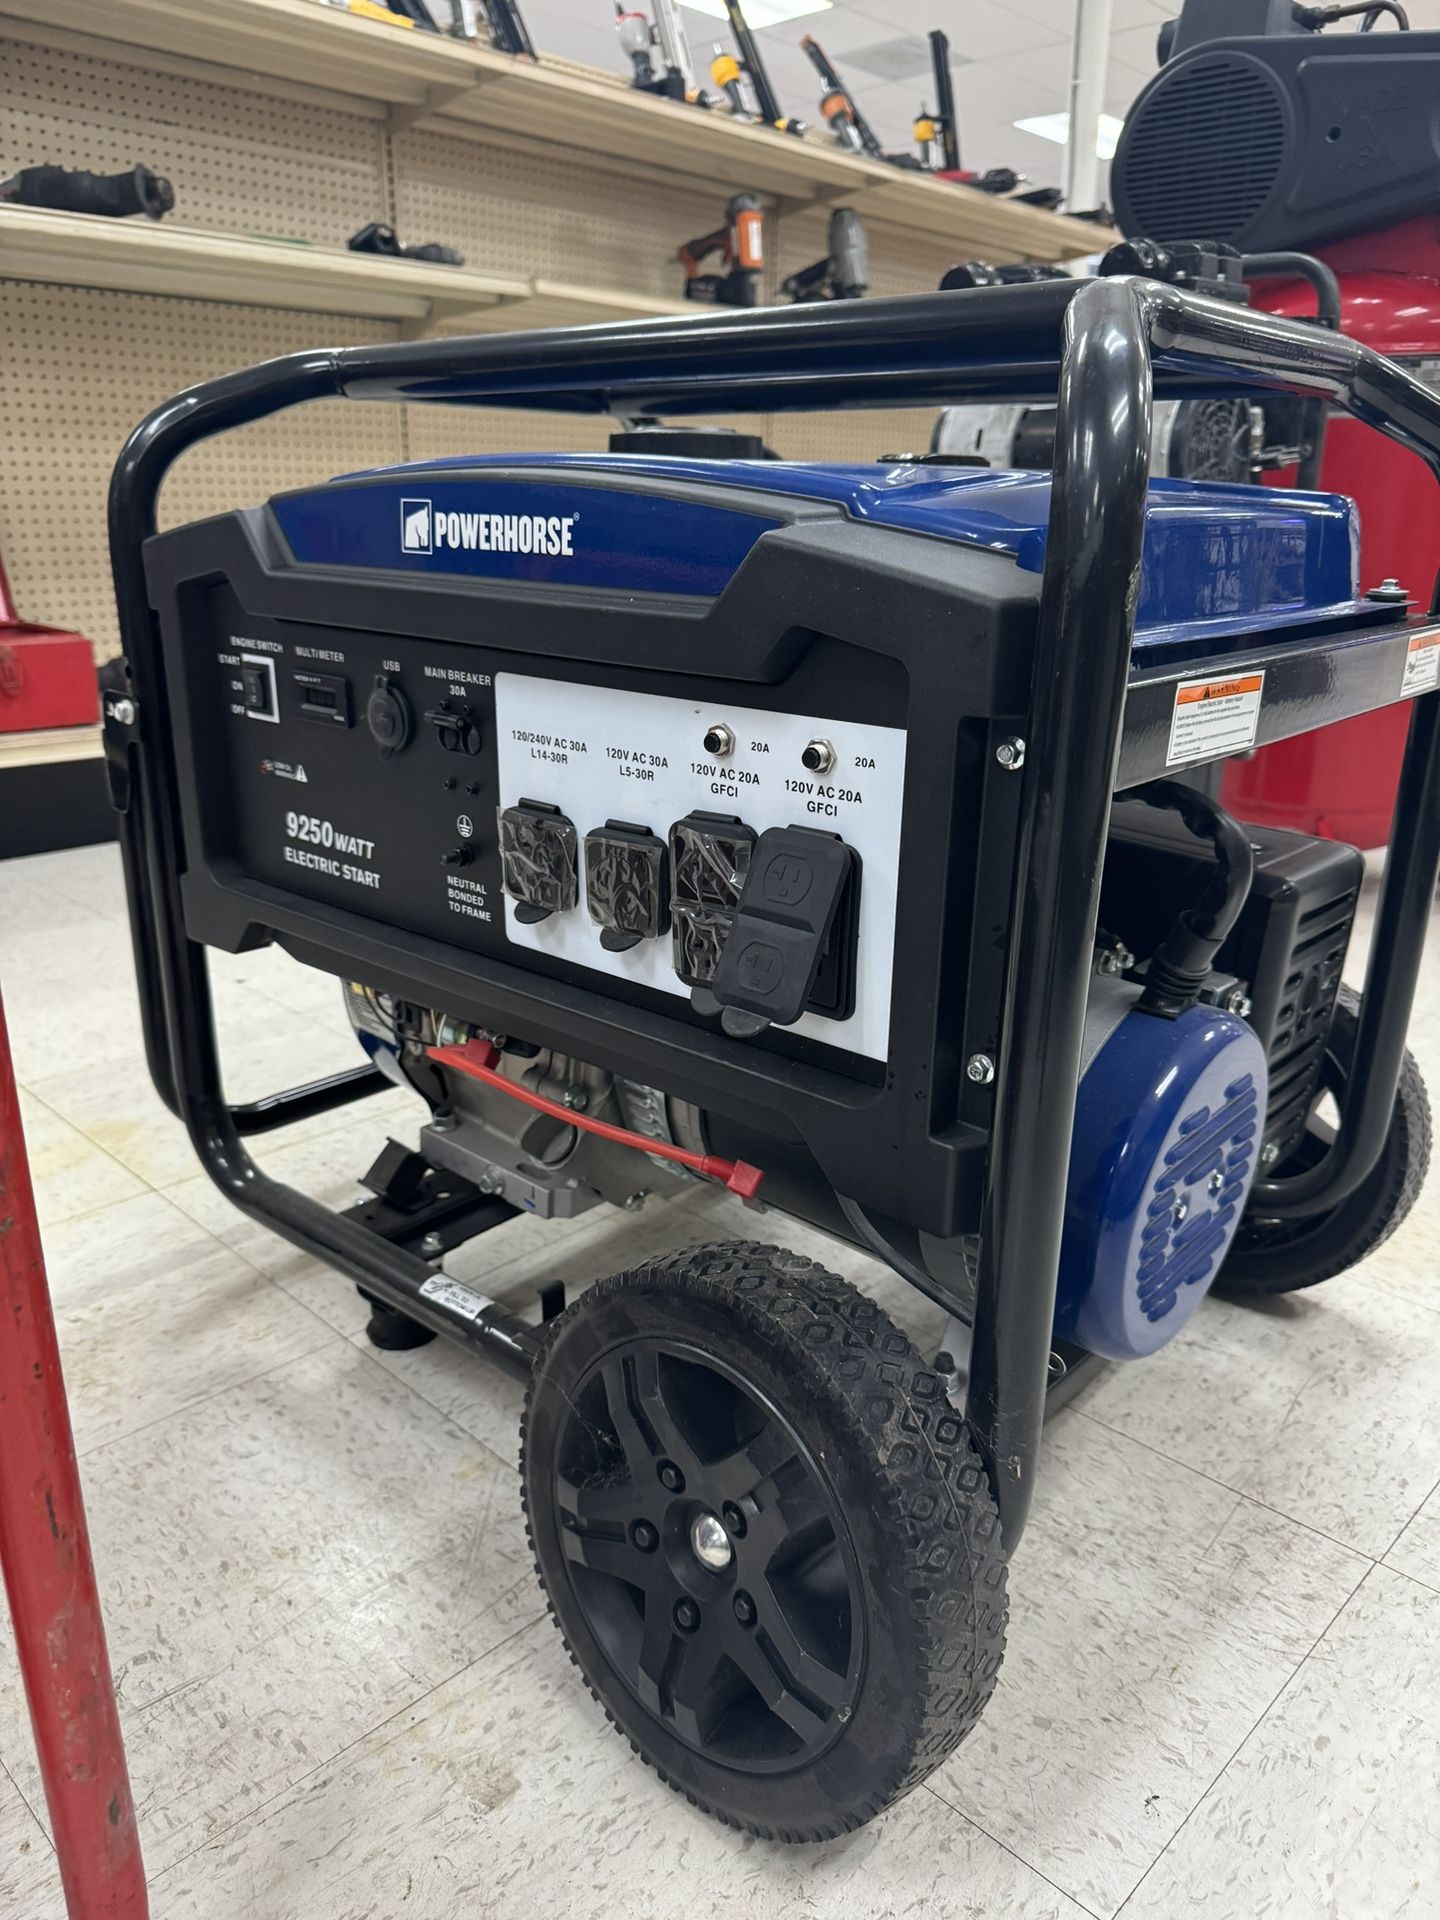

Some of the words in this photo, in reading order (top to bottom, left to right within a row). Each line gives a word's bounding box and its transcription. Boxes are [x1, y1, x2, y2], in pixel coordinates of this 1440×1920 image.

[434, 511, 574, 557] POWERHORSE
[230, 636, 257, 650] ENGINE
[257, 640, 284, 653] SWITCH
[218, 653, 241, 666] START
[382, 659, 401, 672] USB
[424, 666, 447, 680] MAIN
[447, 669, 492, 686] BREAKER
[231, 680, 244, 691] ON
[449, 685, 467, 697] 30A
[231, 703, 246, 715] OFF
[512, 730, 552, 746] 120/240V
[554, 737, 568, 750] AC
[569, 741, 588, 753] 30A
[751, 741, 770, 754] 20A
[531, 748, 568, 764] L14-30R
[606, 747, 630, 761] 120V
[632, 752, 647, 765] AC
[649, 755, 669, 768] 30A
[855, 756, 876, 769] 20A
[619, 765, 654, 781] L5-30R
[690, 762, 716, 777] 120V
[719, 768, 736, 781] AC
[738, 771, 760, 785] 20A
[710, 782, 738, 798] GFCI
[785, 779, 814, 794] 120V
[817, 785, 835, 799] AC
[838, 789, 863, 804] 20A
[806, 800, 838, 817] GFCI
[286, 811, 334, 848] 9250
[334, 832, 375, 859] WATT
[284, 846, 341, 878] ELECTRIC
[342, 864, 380, 889] START
[447, 874, 487, 895] NEUTRAL
[448, 888, 485, 907] BONDED
[448, 900, 461, 912] TO
[461, 904, 492, 922] FRAME
